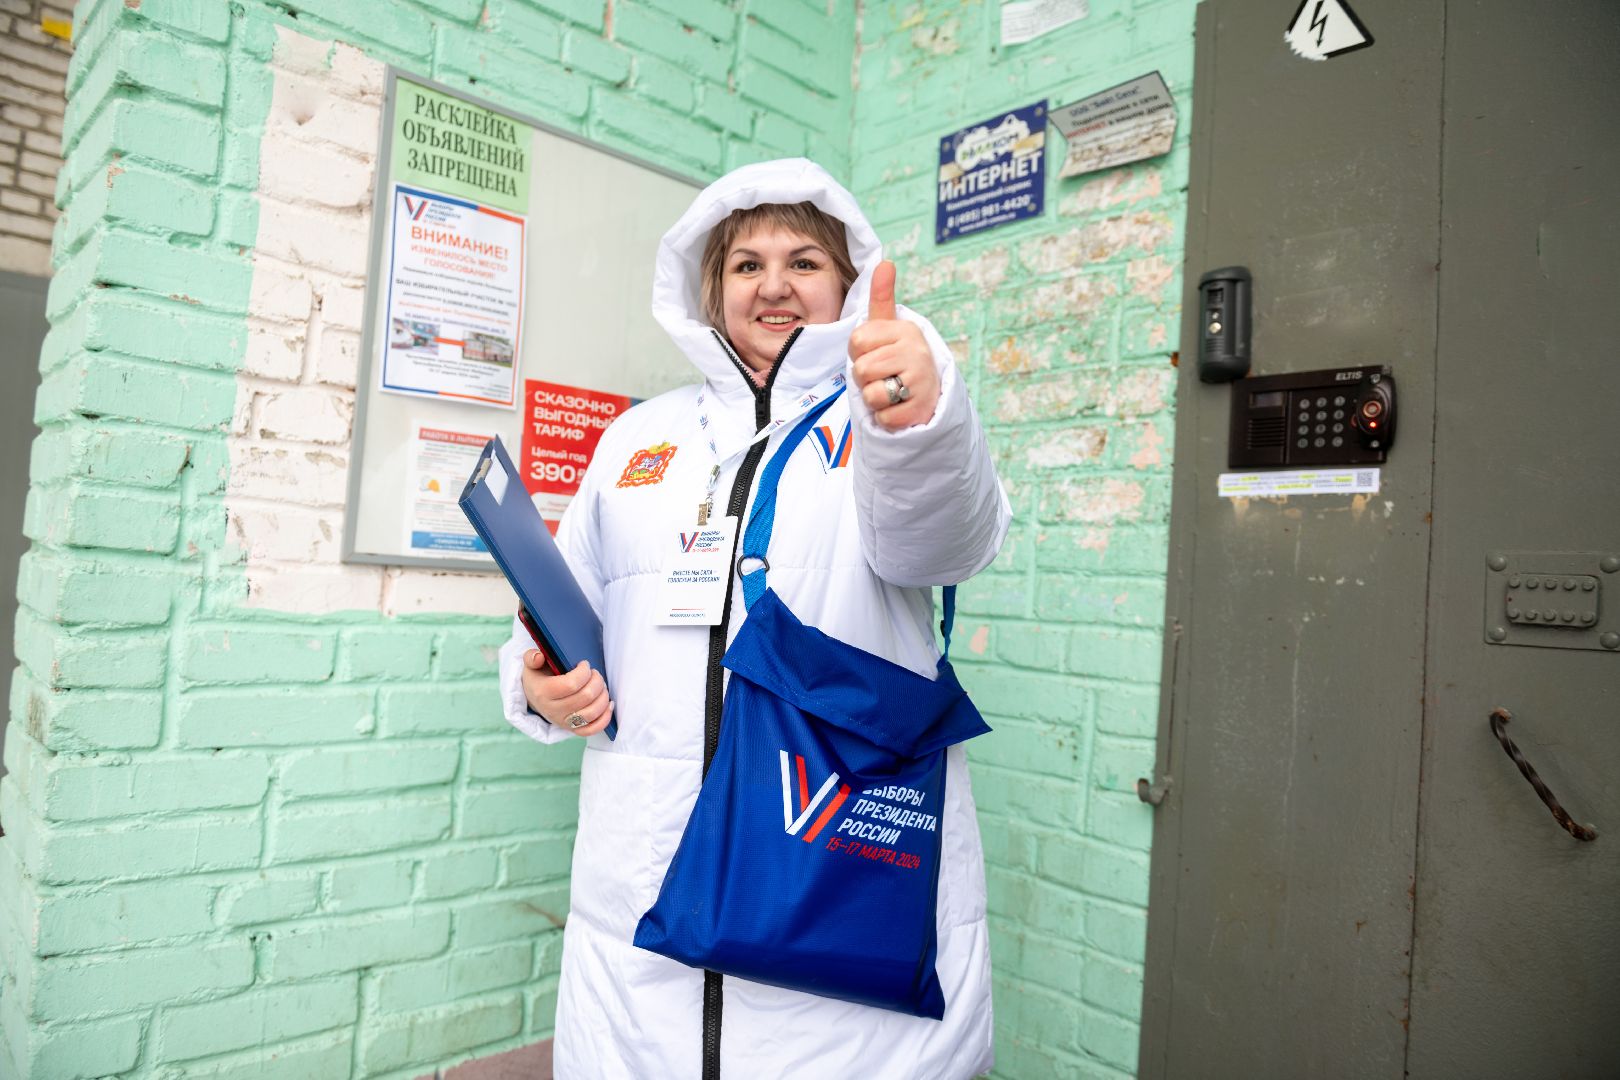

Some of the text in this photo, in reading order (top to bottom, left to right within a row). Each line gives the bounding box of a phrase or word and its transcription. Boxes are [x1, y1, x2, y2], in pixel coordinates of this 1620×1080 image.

[415, 93, 517, 145] РАСКЛЕЙКА
[402, 118, 525, 173] ОБЪЯВЛЕНИЙ
[407, 148, 517, 197] ЗАПРЕЩЕНА
[939, 150, 1043, 203] ИНТЕРНЕТ
[411, 226, 509, 260] ВНИМАНИЕ!
[410, 243, 508, 273] ИЗМЕНИЛОСЬ МЕСТО
[1335, 371, 1363, 381] ELTIS
[534, 390, 616, 416] СКАЗОЧНО
[533, 422, 585, 442] ТАРИФ
[531, 445, 587, 464] Целый год
[530, 460, 576, 484] 390
[851, 798, 937, 832] ПРЕЗИДЕНТА
[836, 818, 902, 846] РОССИИ
[858, 844, 895, 866] МАРТА
[895, 852, 922, 870] 2024
